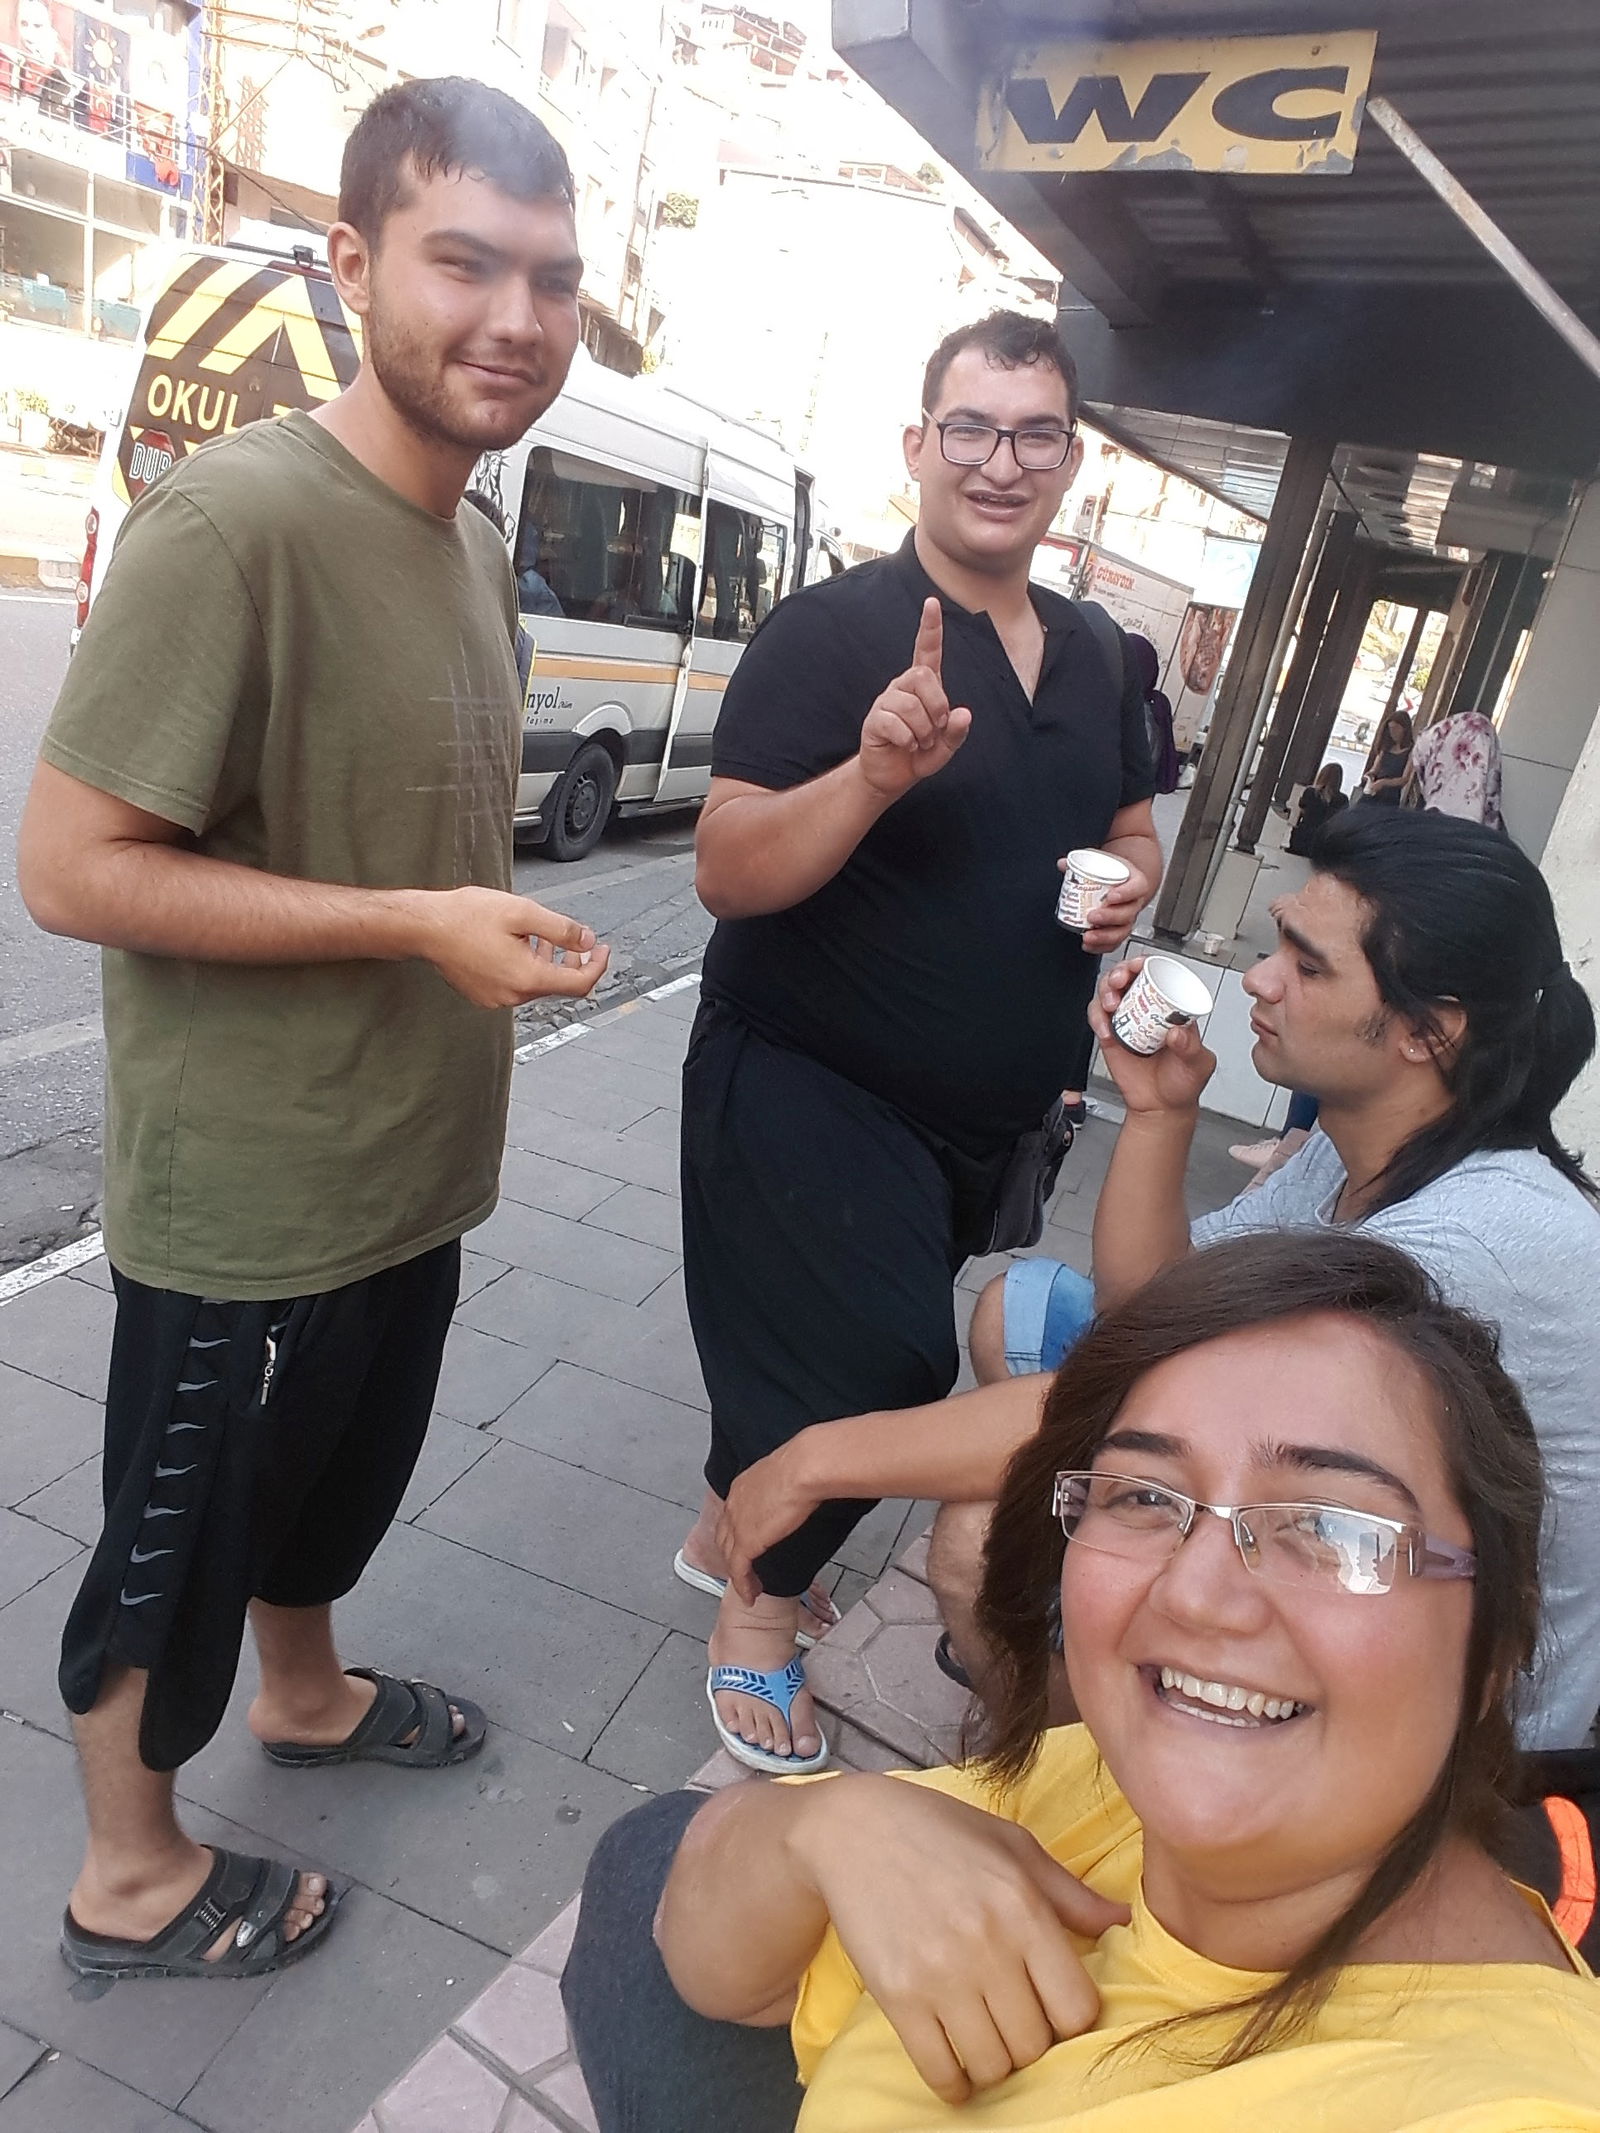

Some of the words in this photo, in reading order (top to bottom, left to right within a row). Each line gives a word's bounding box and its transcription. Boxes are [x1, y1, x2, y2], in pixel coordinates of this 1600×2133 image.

[1004, 66, 1350, 144] WC
[147, 374, 239, 434] OKUL
[526, 686, 560, 714] nyol
